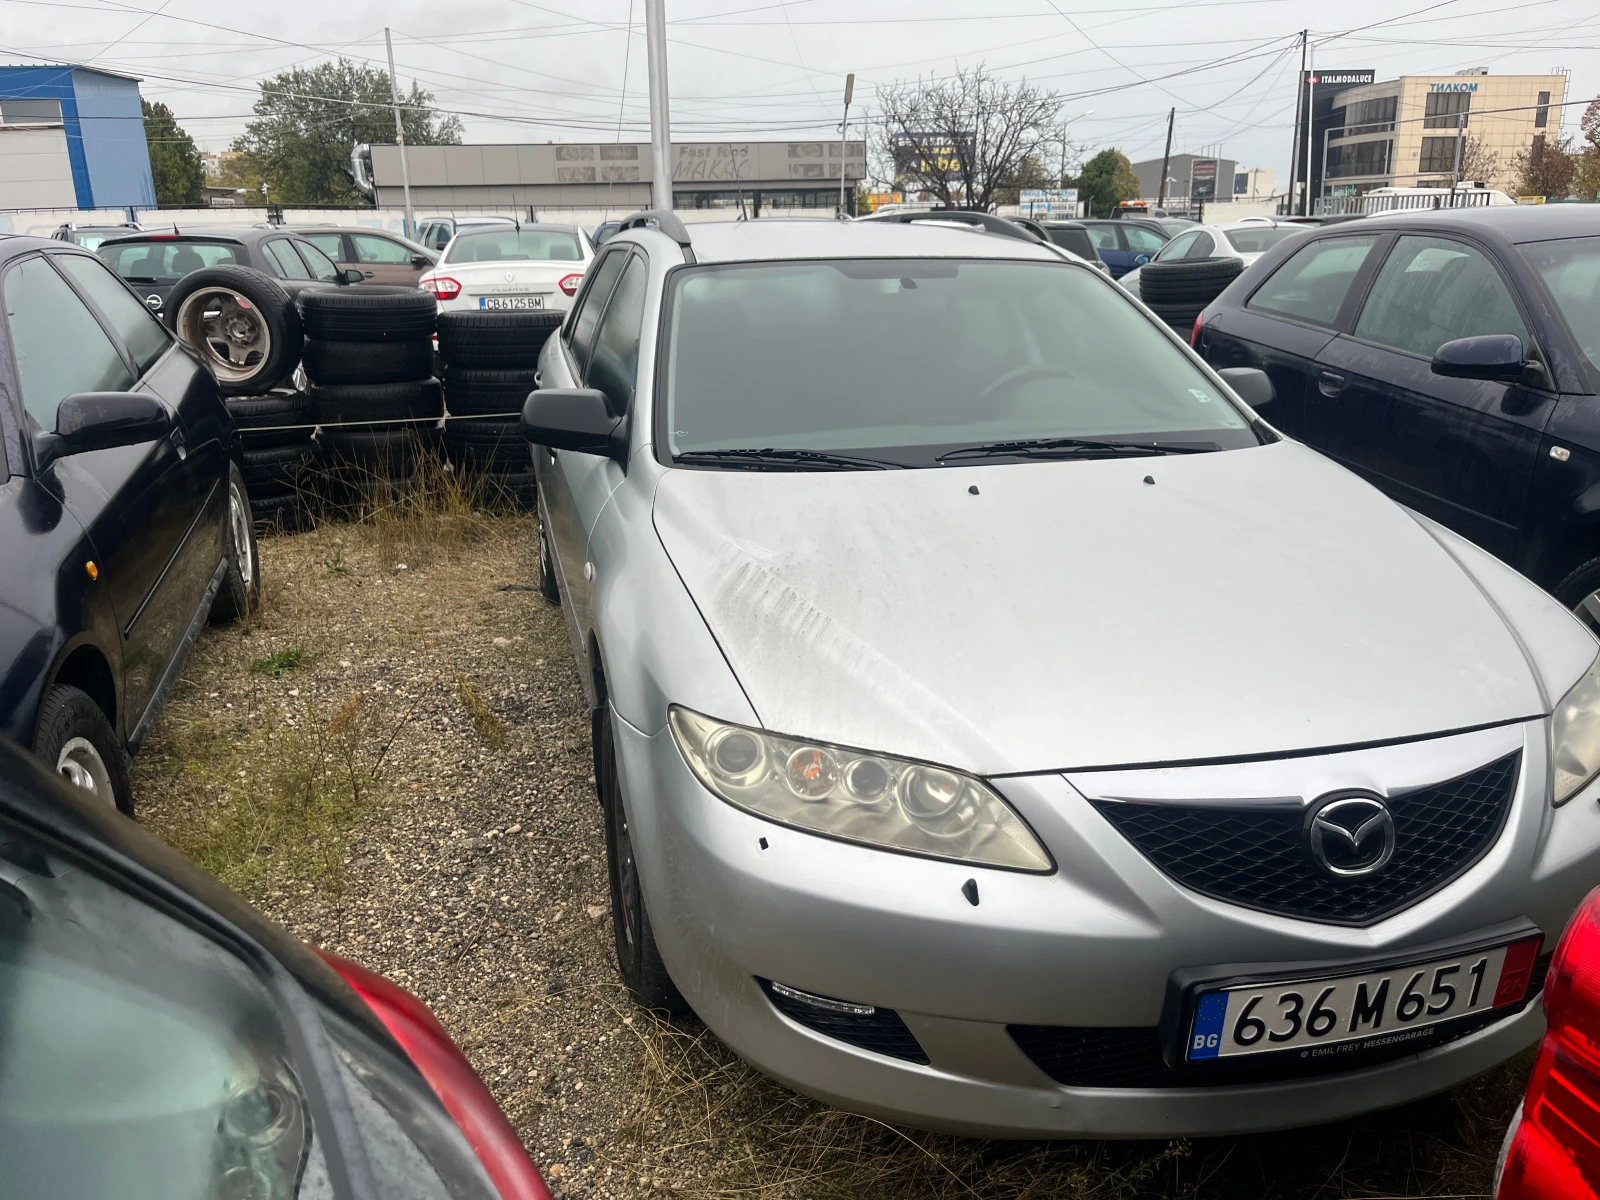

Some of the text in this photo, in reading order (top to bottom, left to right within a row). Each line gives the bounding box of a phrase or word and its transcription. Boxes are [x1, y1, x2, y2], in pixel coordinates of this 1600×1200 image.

[1321, 74, 1372, 84] ITALMODALUCE
[1430, 82, 1478, 93] ТИЛКОМ
[679, 145, 749, 158] Fast food
[502, 298, 527, 309] 6125
[1233, 956, 1488, 1047] 636 M 651
[1193, 1034, 1218, 1050] BG
[1311, 1027, 1435, 1057] EMIL FREY HESSENGARAGE
